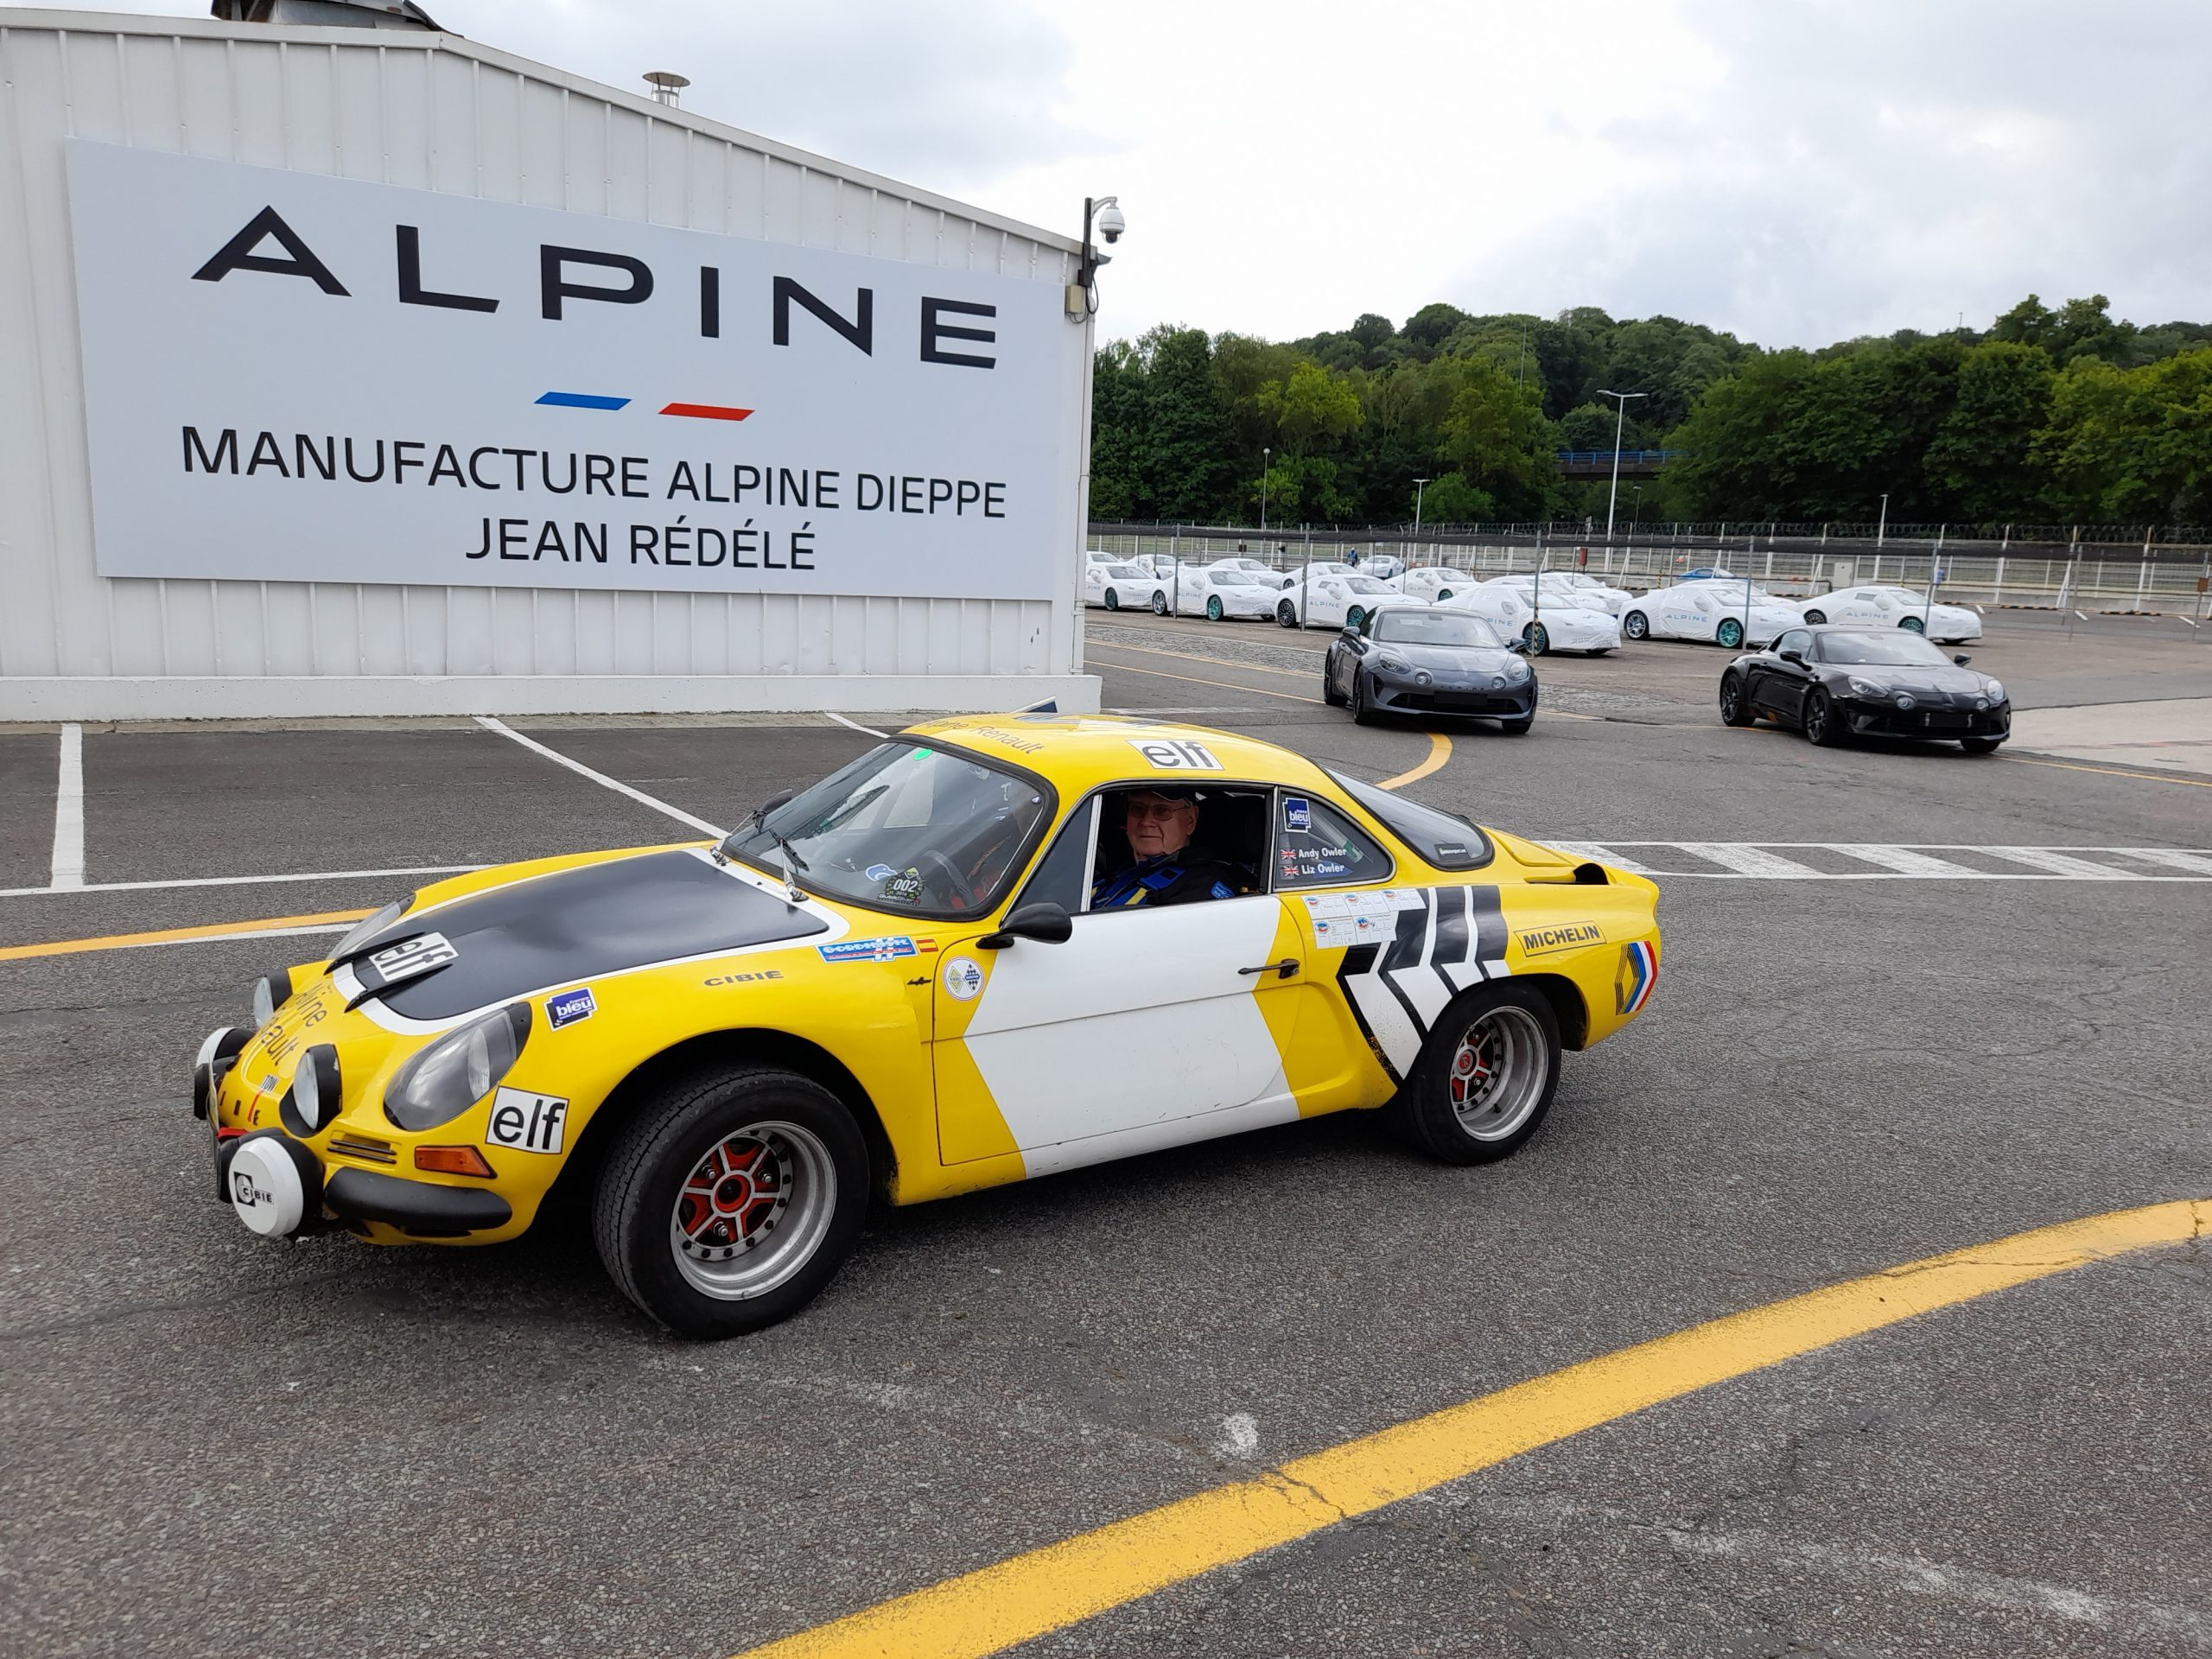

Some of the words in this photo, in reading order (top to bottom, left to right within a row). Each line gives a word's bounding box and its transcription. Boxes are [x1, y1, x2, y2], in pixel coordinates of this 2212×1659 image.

[190, 204, 997, 370] ALPINE
[182, 425, 650, 499] MANUFACTURE
[666, 461, 840, 510] ALPINE
[857, 473, 1007, 518] DIEPPE
[466, 518, 607, 563] JEAN
[630, 515, 816, 570] RÉDÉLÉ
[1309, 601, 1340, 609] ALPINE
[1485, 617, 1513, 626] PINE
[1665, 613, 1708, 623] ALPINE
[1846, 611, 1889, 620] ALPINE
[969, 725, 1046, 754] Renault
[1141, 741, 1214, 768] elf
[1288, 810, 1309, 823] bleu
[1298, 848, 1319, 860] Andy
[1321, 846, 1347, 857] Owler
[1300, 864, 1315, 874] Liz
[1317, 862, 1345, 874] Owler
[893, 878, 918, 893] 002
[1523, 925, 1600, 950] MICHELIN
[374, 941, 454, 977] elf
[703, 970, 785, 987] CIBIE
[556, 998, 593, 1017] bleu
[493, 1098, 566, 1151] elf
[243, 1186, 273, 1204] CIBIE
